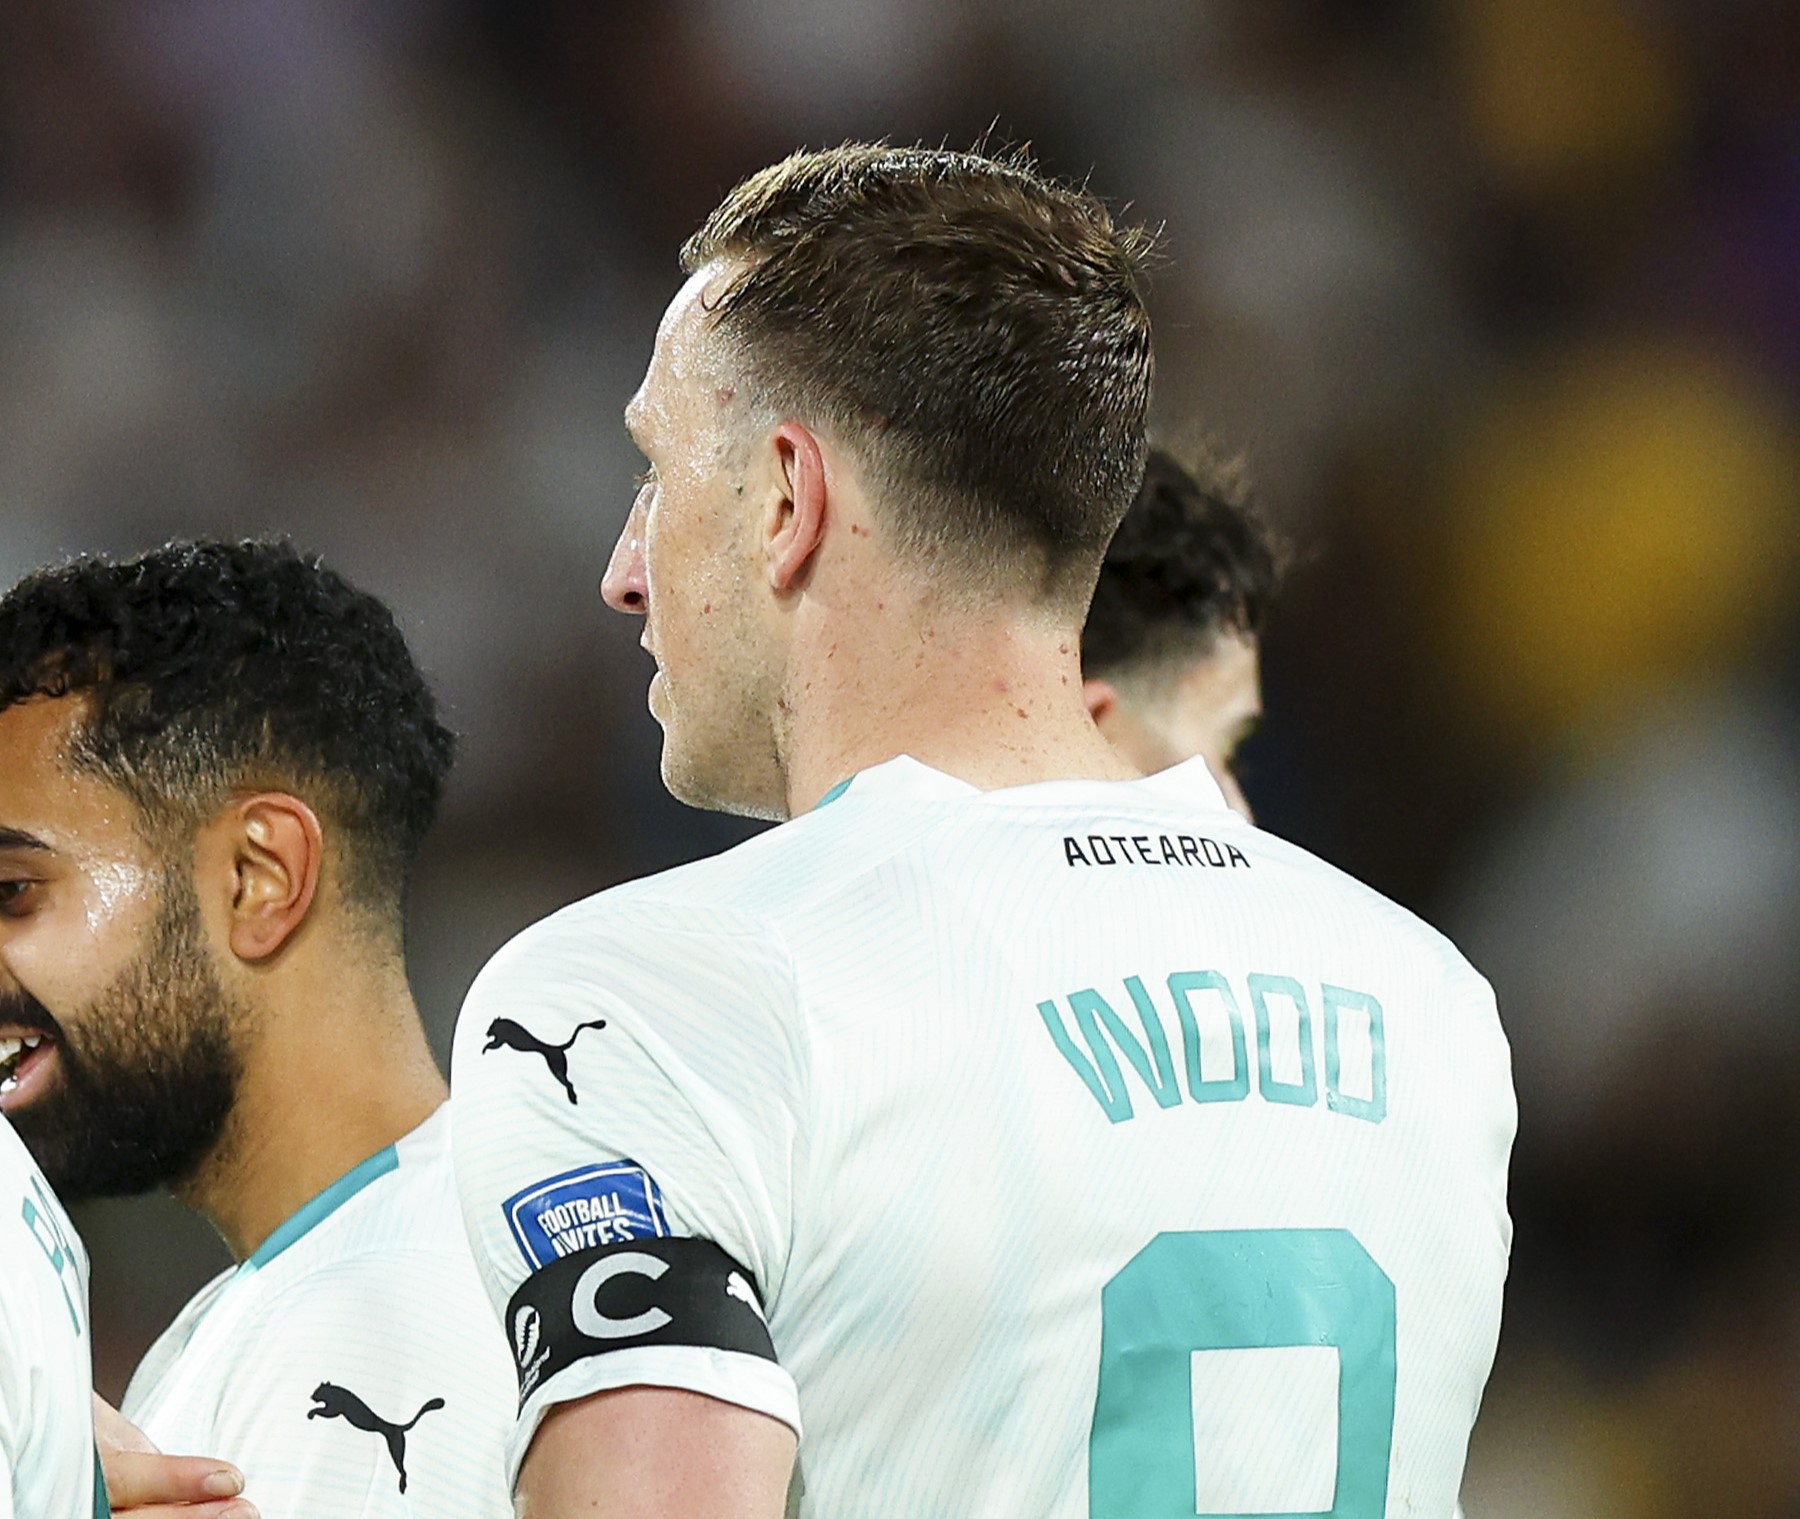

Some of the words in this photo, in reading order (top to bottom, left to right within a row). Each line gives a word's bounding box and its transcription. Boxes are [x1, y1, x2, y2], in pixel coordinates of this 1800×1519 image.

[1063, 835, 1251, 868] AOTEAROA
[1036, 970, 1387, 1124] WOOD
[537, 1192, 626, 1238] FOOTBALL
[572, 1251, 673, 1339] C
